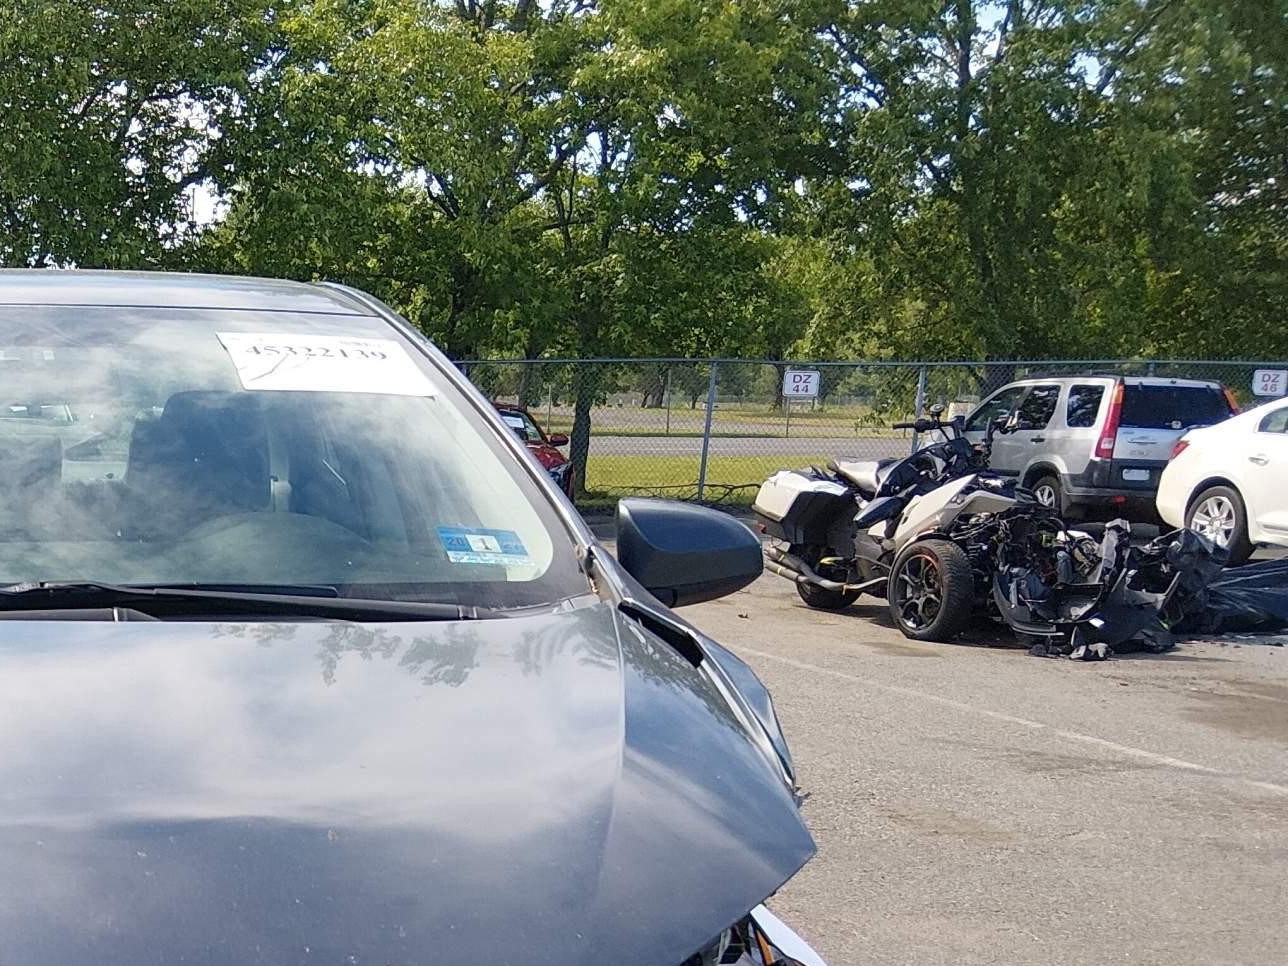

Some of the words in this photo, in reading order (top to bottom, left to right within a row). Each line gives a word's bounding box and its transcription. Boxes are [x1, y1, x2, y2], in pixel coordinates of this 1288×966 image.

[792, 374, 813, 384] DZ
[1262, 373, 1281, 383] DZ
[792, 384, 809, 393] 44
